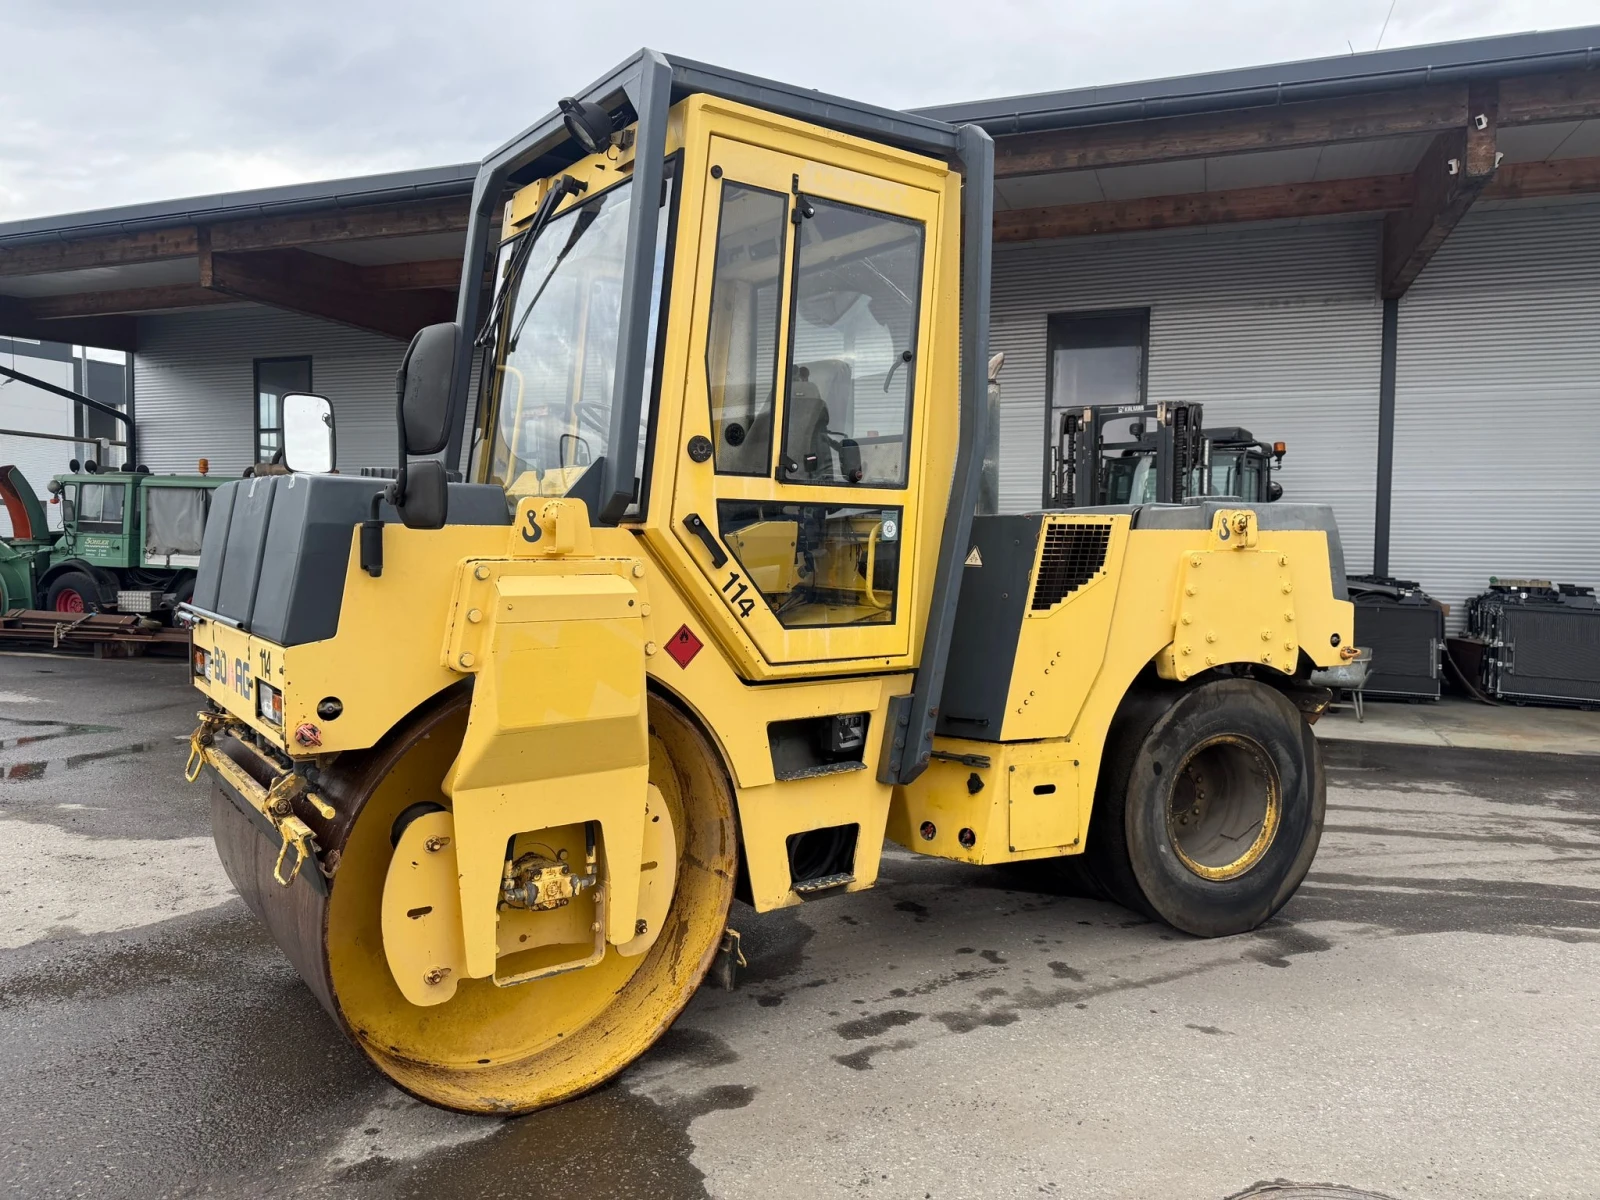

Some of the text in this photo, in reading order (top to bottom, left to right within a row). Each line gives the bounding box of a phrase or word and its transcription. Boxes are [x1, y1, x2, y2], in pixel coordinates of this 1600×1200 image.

[722, 571, 756, 618] 114
[214, 646, 251, 701] BOAG
[260, 648, 271, 681] 114
